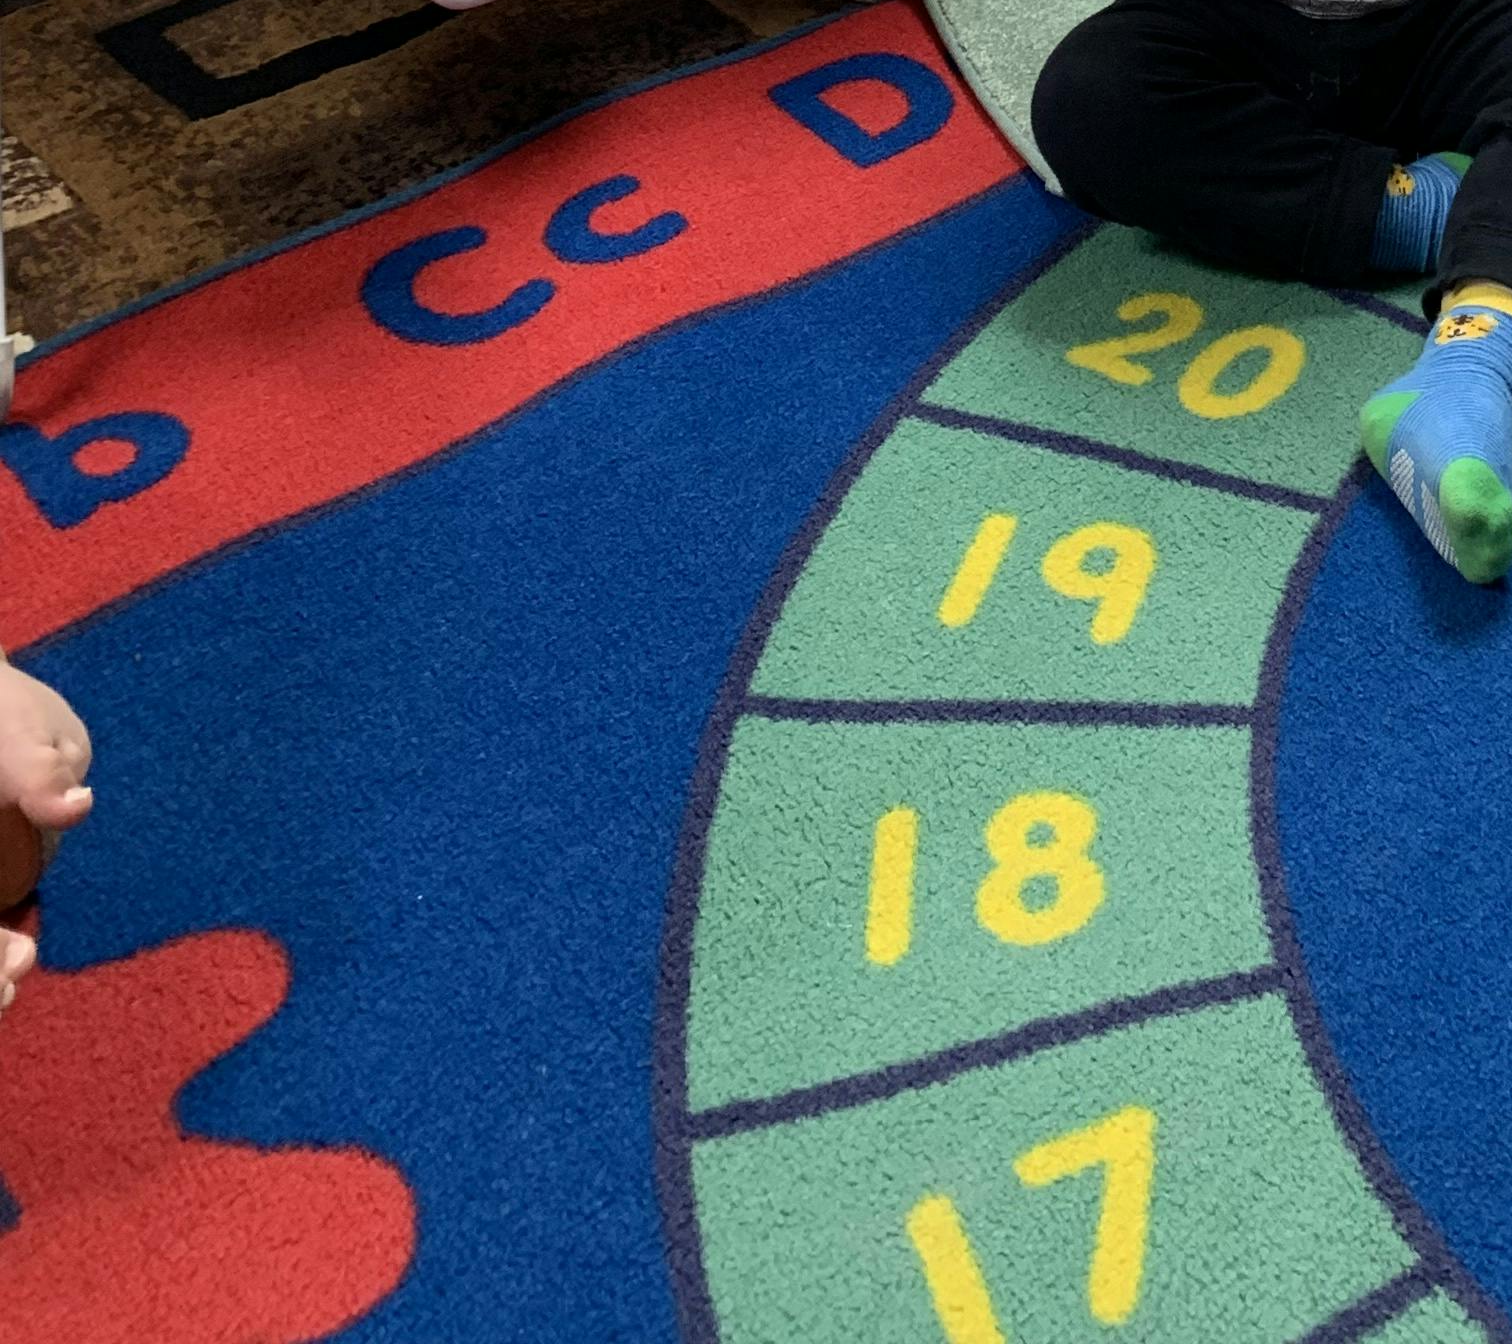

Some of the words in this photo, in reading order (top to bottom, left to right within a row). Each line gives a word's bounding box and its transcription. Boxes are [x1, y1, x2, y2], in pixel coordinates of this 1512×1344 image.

[769, 51, 955, 169] D
[1066, 291, 1307, 419] 20
[939, 513, 1159, 646] 19
[866, 792, 1105, 966] 18
[905, 1106, 1156, 1344] 17
